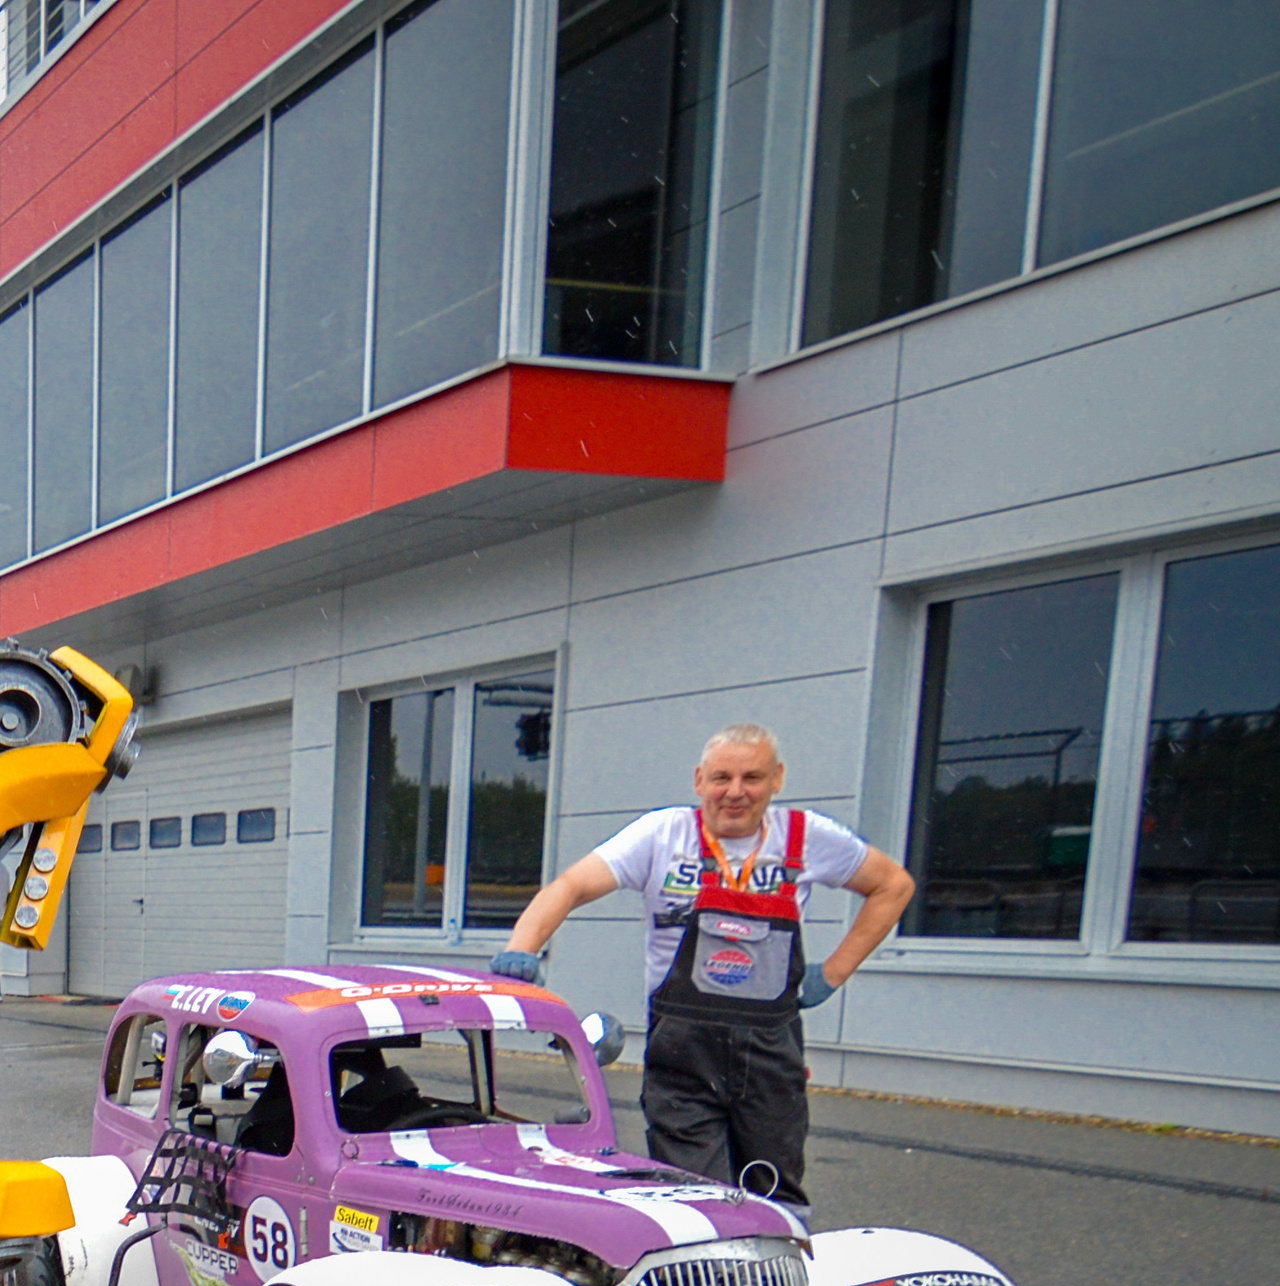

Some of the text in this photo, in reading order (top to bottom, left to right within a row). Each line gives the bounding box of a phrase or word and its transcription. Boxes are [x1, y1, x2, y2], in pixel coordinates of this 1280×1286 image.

[337, 1207, 374, 1231] Sabelt
[186, 1240, 239, 1276] CUPPER
[252, 1214, 289, 1271] 58
